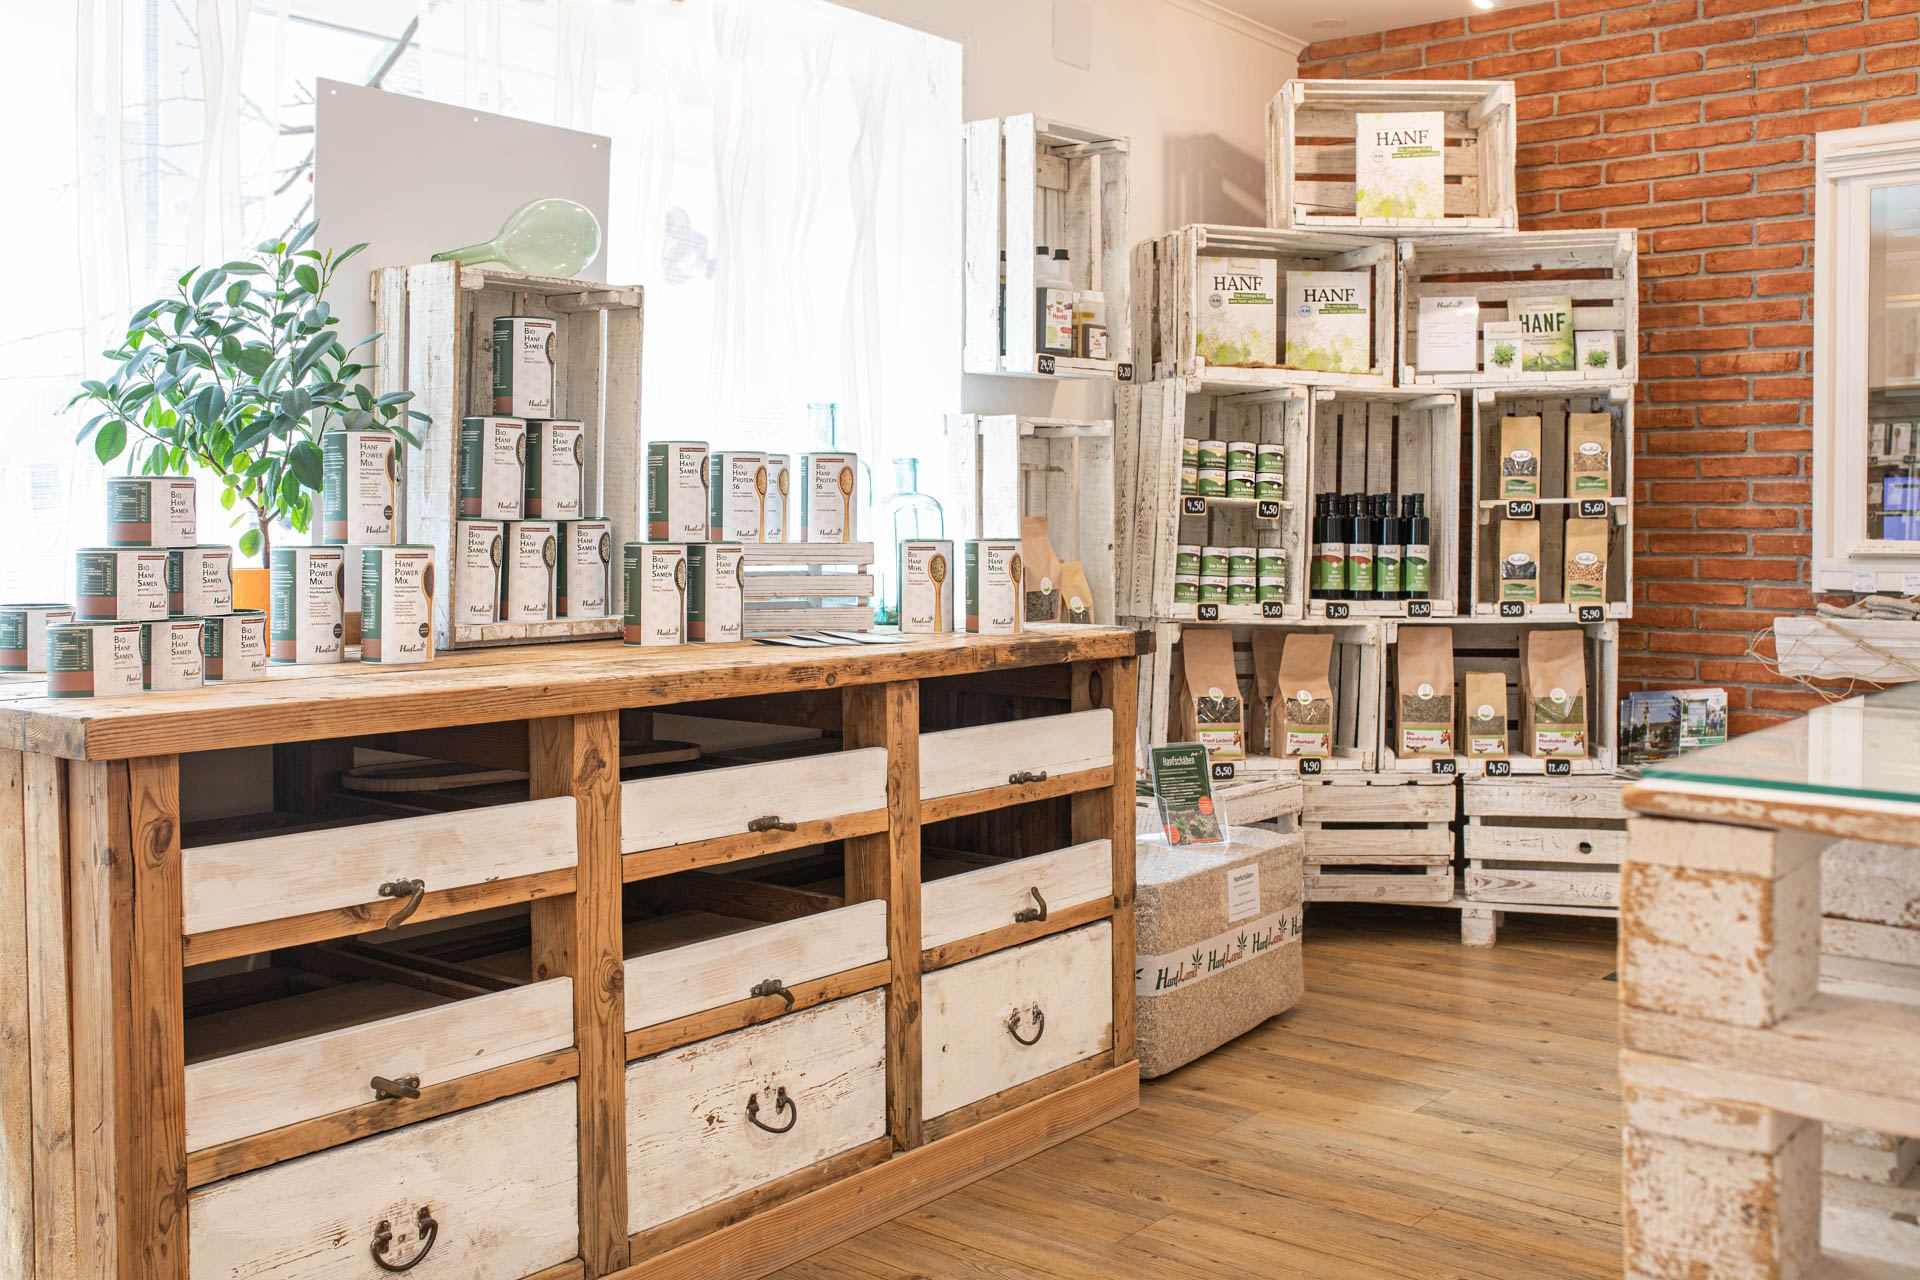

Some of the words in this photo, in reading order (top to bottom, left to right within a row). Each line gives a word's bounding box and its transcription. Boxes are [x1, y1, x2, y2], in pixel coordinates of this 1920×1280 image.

[1376, 130, 1428, 146] HANF
[1214, 276, 1263, 290] HANF
[1304, 289, 1355, 302] HANF
[1520, 312, 1565, 333] HANF
[1040, 360, 1054, 370] 24,90
[1188, 500, 1204, 512] 4,50
[1262, 505, 1278, 514] 4,50
[1511, 503, 1532, 513] 5,60
[1585, 502, 1604, 513] 5,60
[1201, 607, 1216, 618] 4,50
[1264, 605, 1281, 615] 3,60
[1329, 606, 1347, 617] 7,30
[1411, 604, 1430, 614] 18,50
[1503, 605, 1522, 614] 5,90
[1582, 610, 1600, 619] 5,90
[1215, 766, 1232, 777] 8,50
[1303, 761, 1320, 772] 4,90
[1435, 763, 1454, 773] 7,60
[1489, 762, 1508, 774] 4,50
[1548, 763, 1569, 772] 12,60
[1155, 961, 1198, 990] HanfLand
[1208, 944, 1242, 972] HanfLand
[1252, 927, 1284, 953] HanfLand
